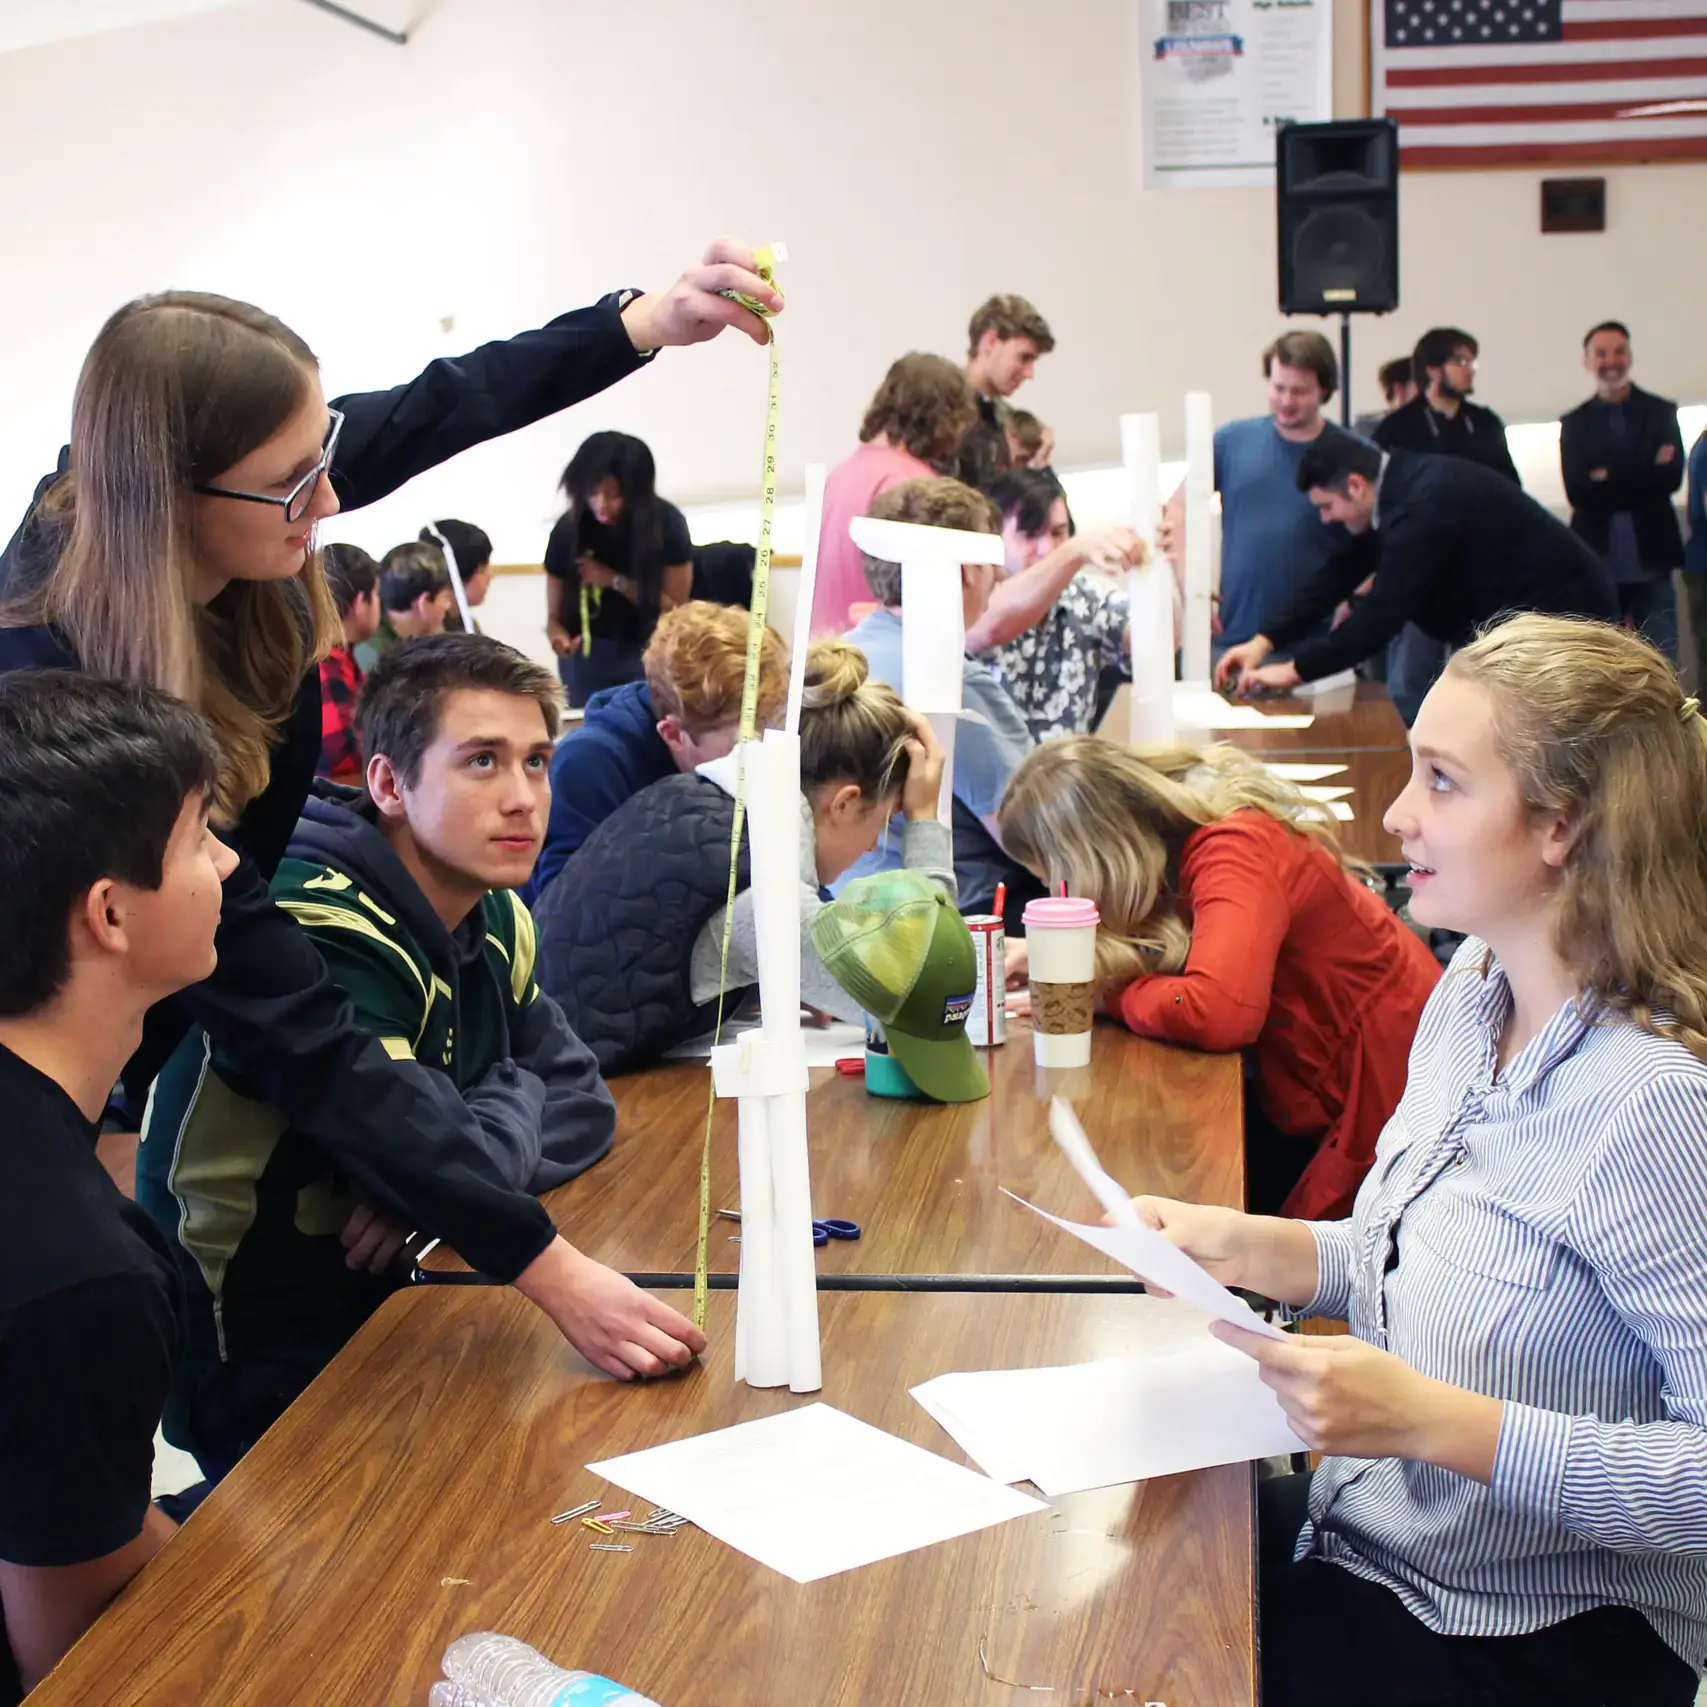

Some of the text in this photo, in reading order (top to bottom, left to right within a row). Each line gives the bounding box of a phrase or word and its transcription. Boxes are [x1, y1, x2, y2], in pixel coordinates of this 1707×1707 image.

[767, 456, 775, 473] 29
[766, 487, 774, 504] 28
[763, 519, 771, 536] 27
